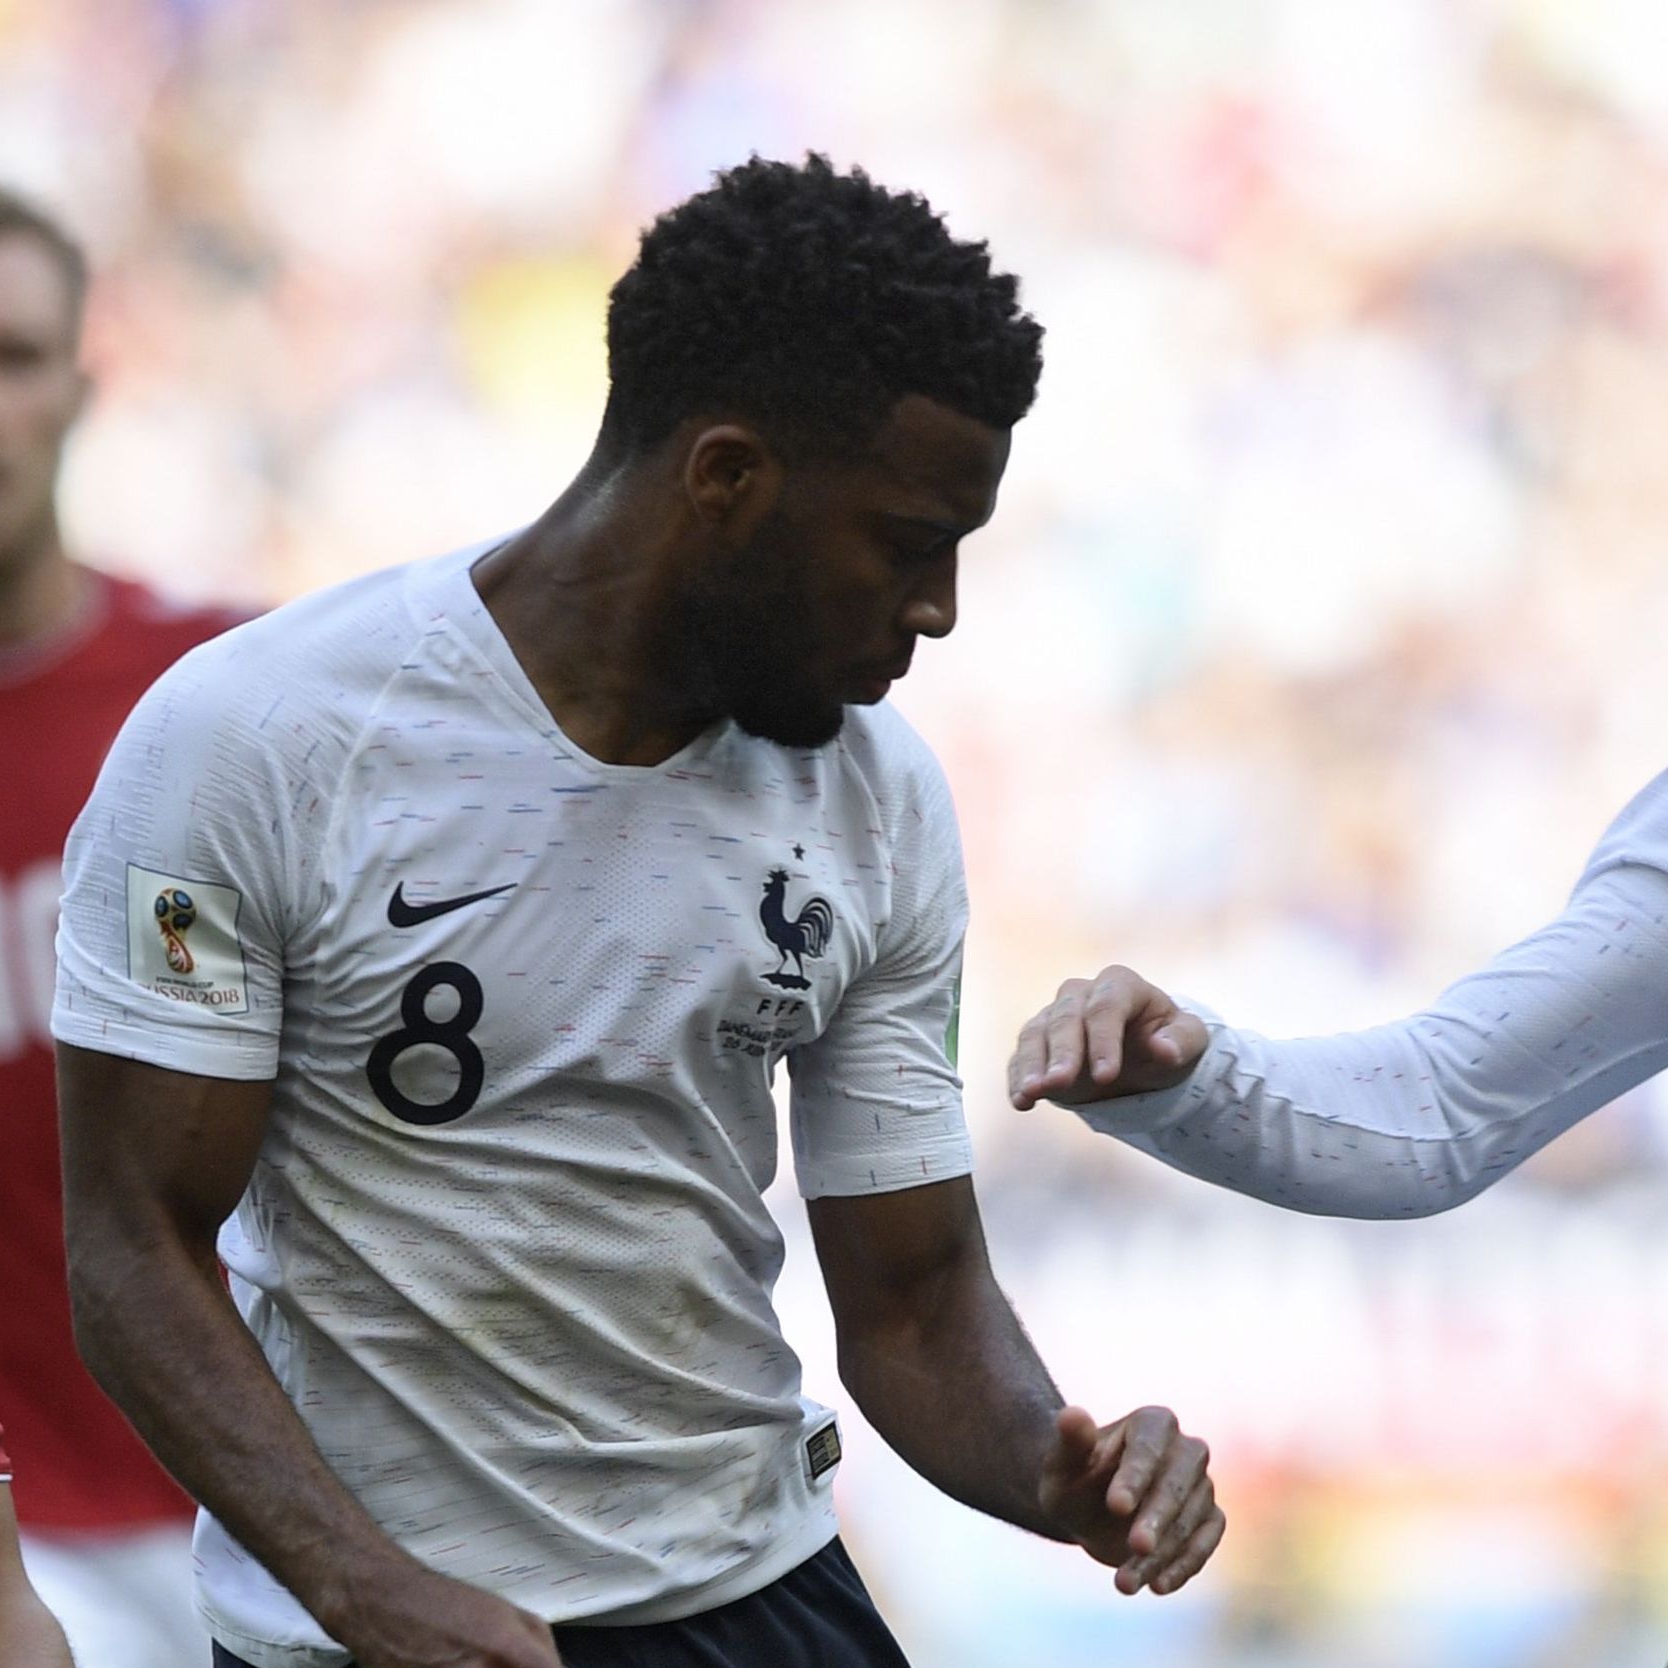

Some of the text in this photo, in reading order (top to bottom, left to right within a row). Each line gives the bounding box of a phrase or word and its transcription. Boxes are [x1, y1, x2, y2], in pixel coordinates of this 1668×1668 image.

[199, 989, 240, 1006] 2018
[756, 1000, 805, 1017] FFF
[366, 961, 484, 1126] 8
